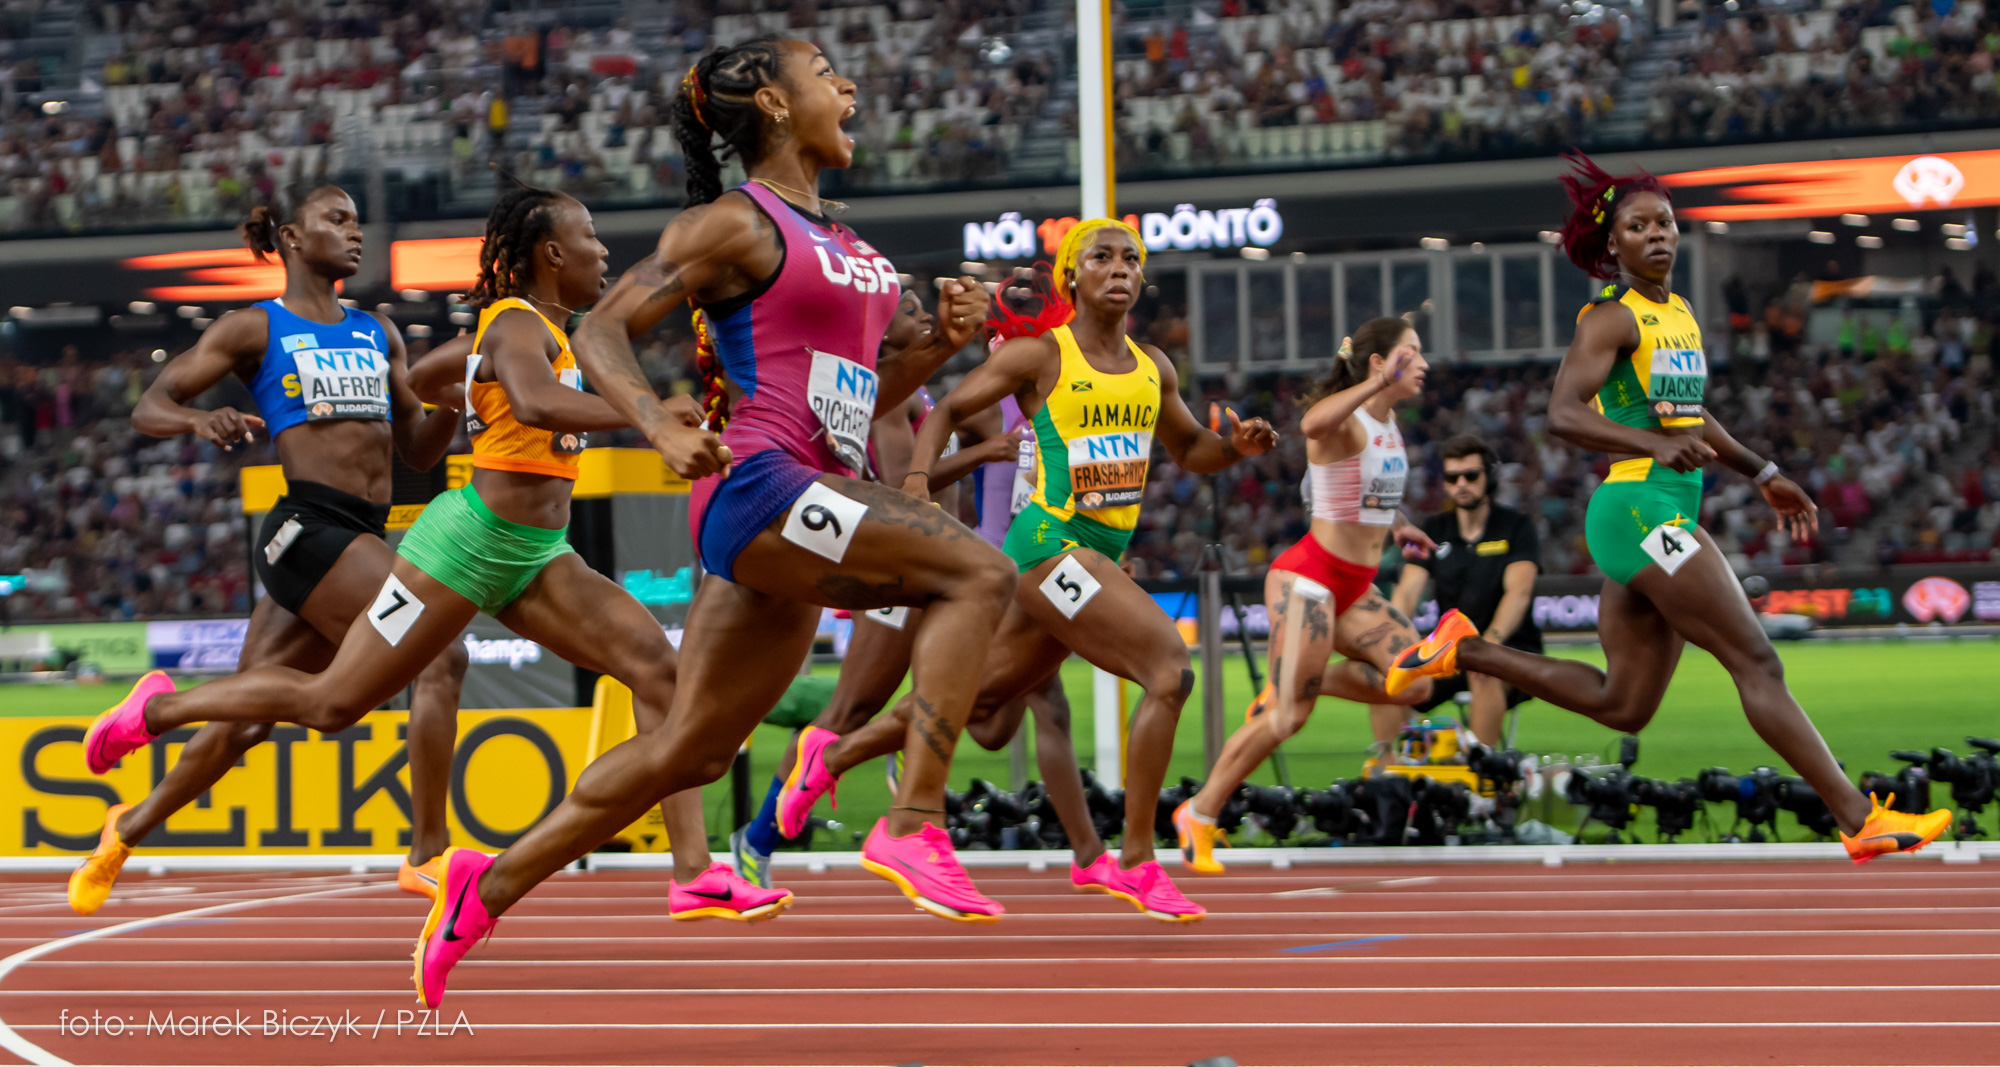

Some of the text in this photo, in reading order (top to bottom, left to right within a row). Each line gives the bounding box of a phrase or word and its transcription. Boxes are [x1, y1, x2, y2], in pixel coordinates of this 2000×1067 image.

[814, 246, 901, 294] USA
[313, 351, 376, 372] NTN
[1669, 350, 1701, 372] NTN
[312, 376, 381, 399] ALFRED
[1087, 433, 1139, 460] NTN
[801, 504, 842, 539] 9
[1661, 530, 1685, 555] 4
[1054, 571, 1082, 602] 5
[377, 589, 409, 621] 7
[464, 633, 541, 671] hamps
[20, 716, 567, 852] SEIKO
